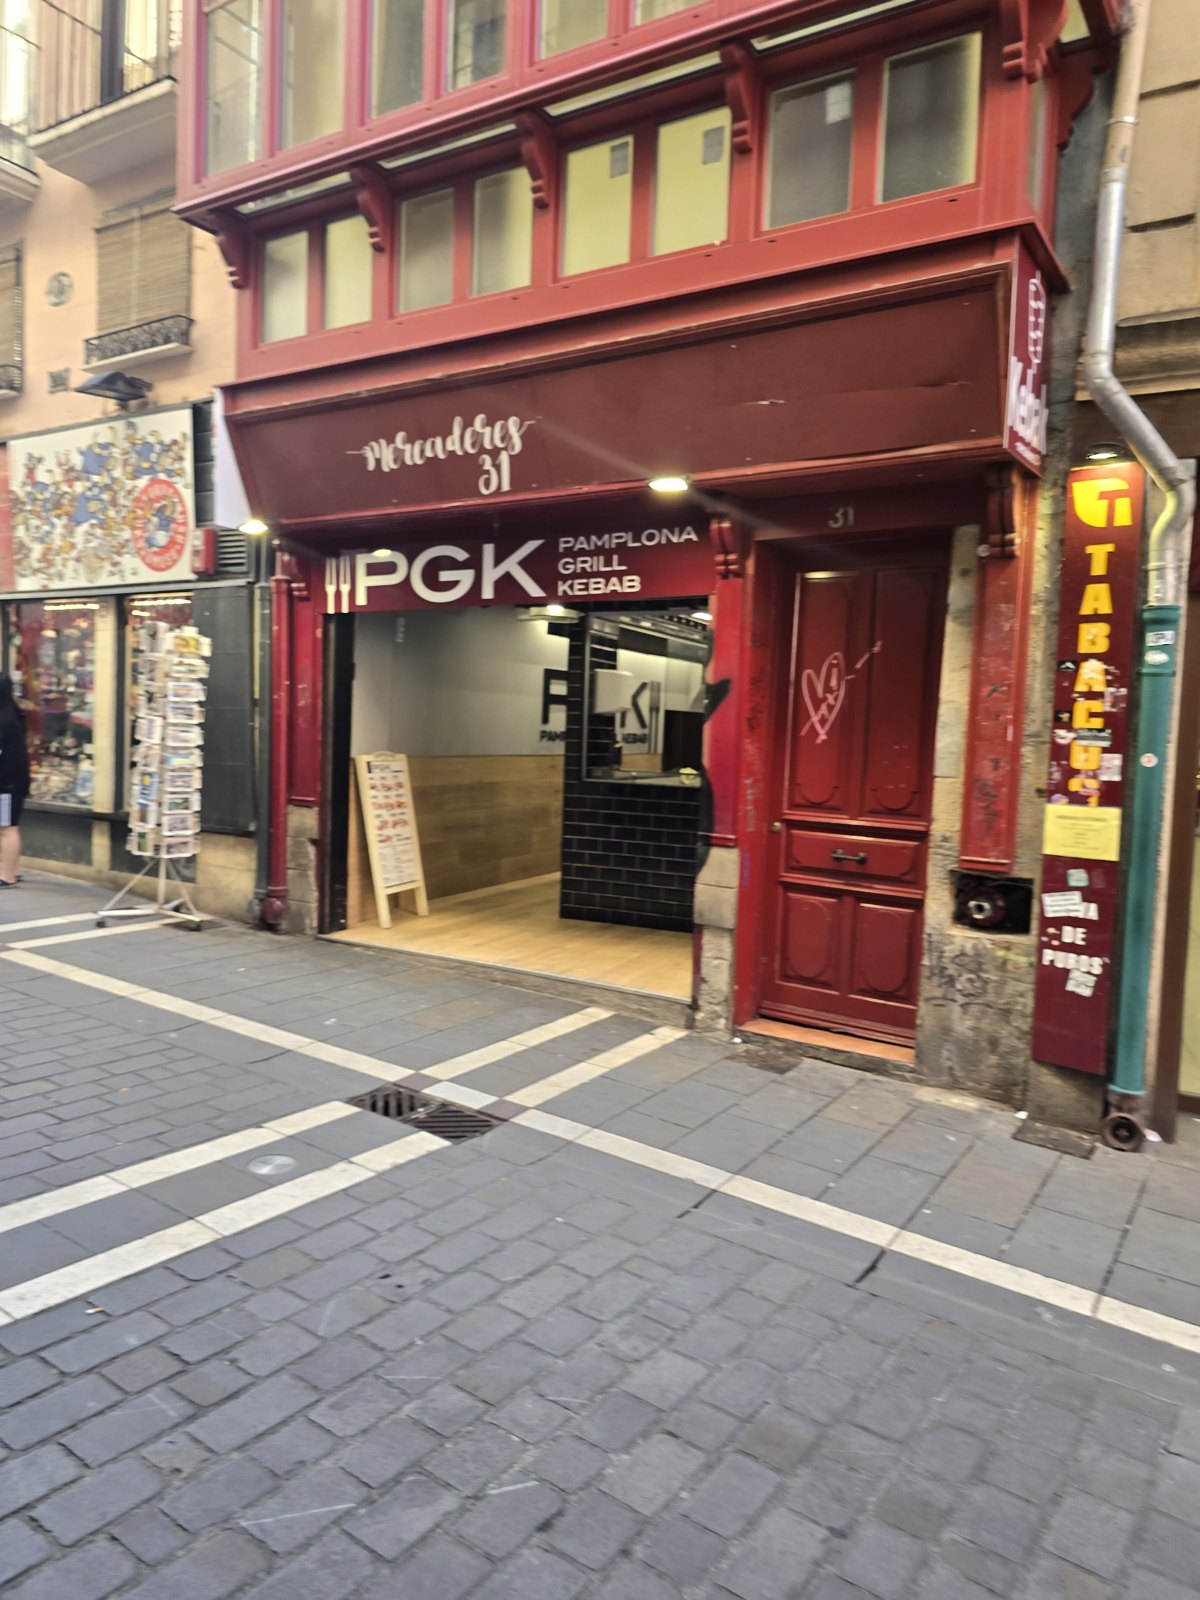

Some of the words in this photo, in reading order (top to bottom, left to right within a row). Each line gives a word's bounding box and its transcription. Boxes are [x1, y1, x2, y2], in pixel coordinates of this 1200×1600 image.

[347, 414, 536, 472] Mercaderes
[478, 451, 511, 495] 31
[827, 506, 855, 528] 31
[558, 525, 699, 553] PAMPLONA
[355, 539, 547, 603] PGK
[557, 556, 628, 575] GRILL
[557, 574, 642, 597] KEBAB
